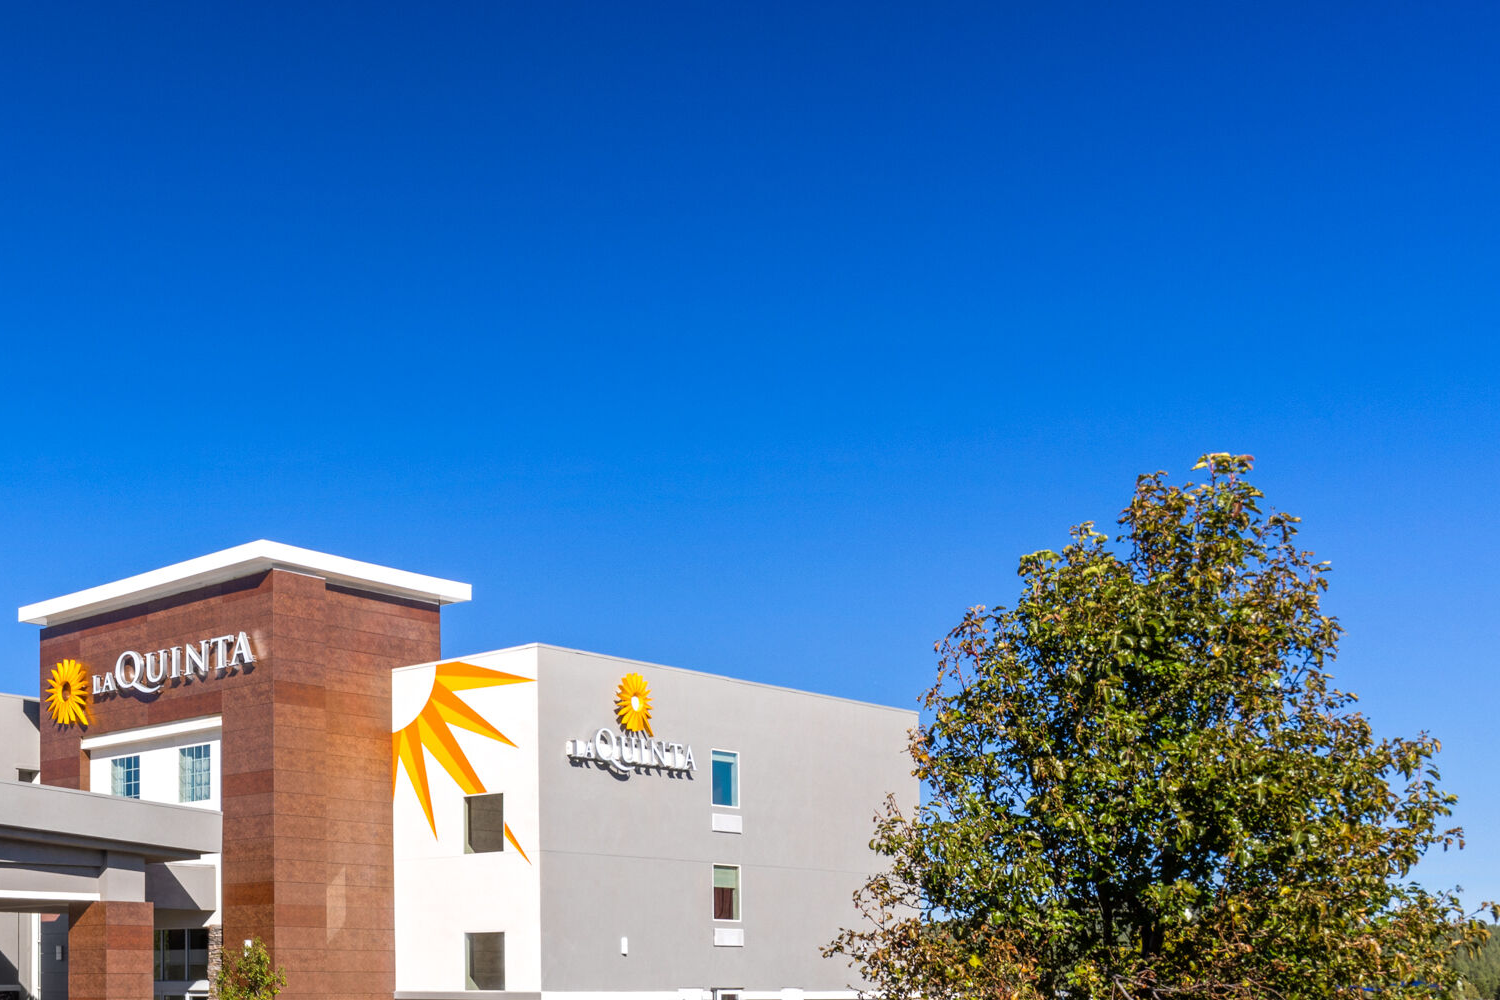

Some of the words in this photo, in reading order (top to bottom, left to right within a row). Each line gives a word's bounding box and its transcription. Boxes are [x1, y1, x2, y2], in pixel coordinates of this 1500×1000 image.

[92, 671, 117, 695] LA
[115, 631, 254, 694] QUINTA
[574, 739, 596, 759] LA
[595, 728, 697, 771] QUINTA
